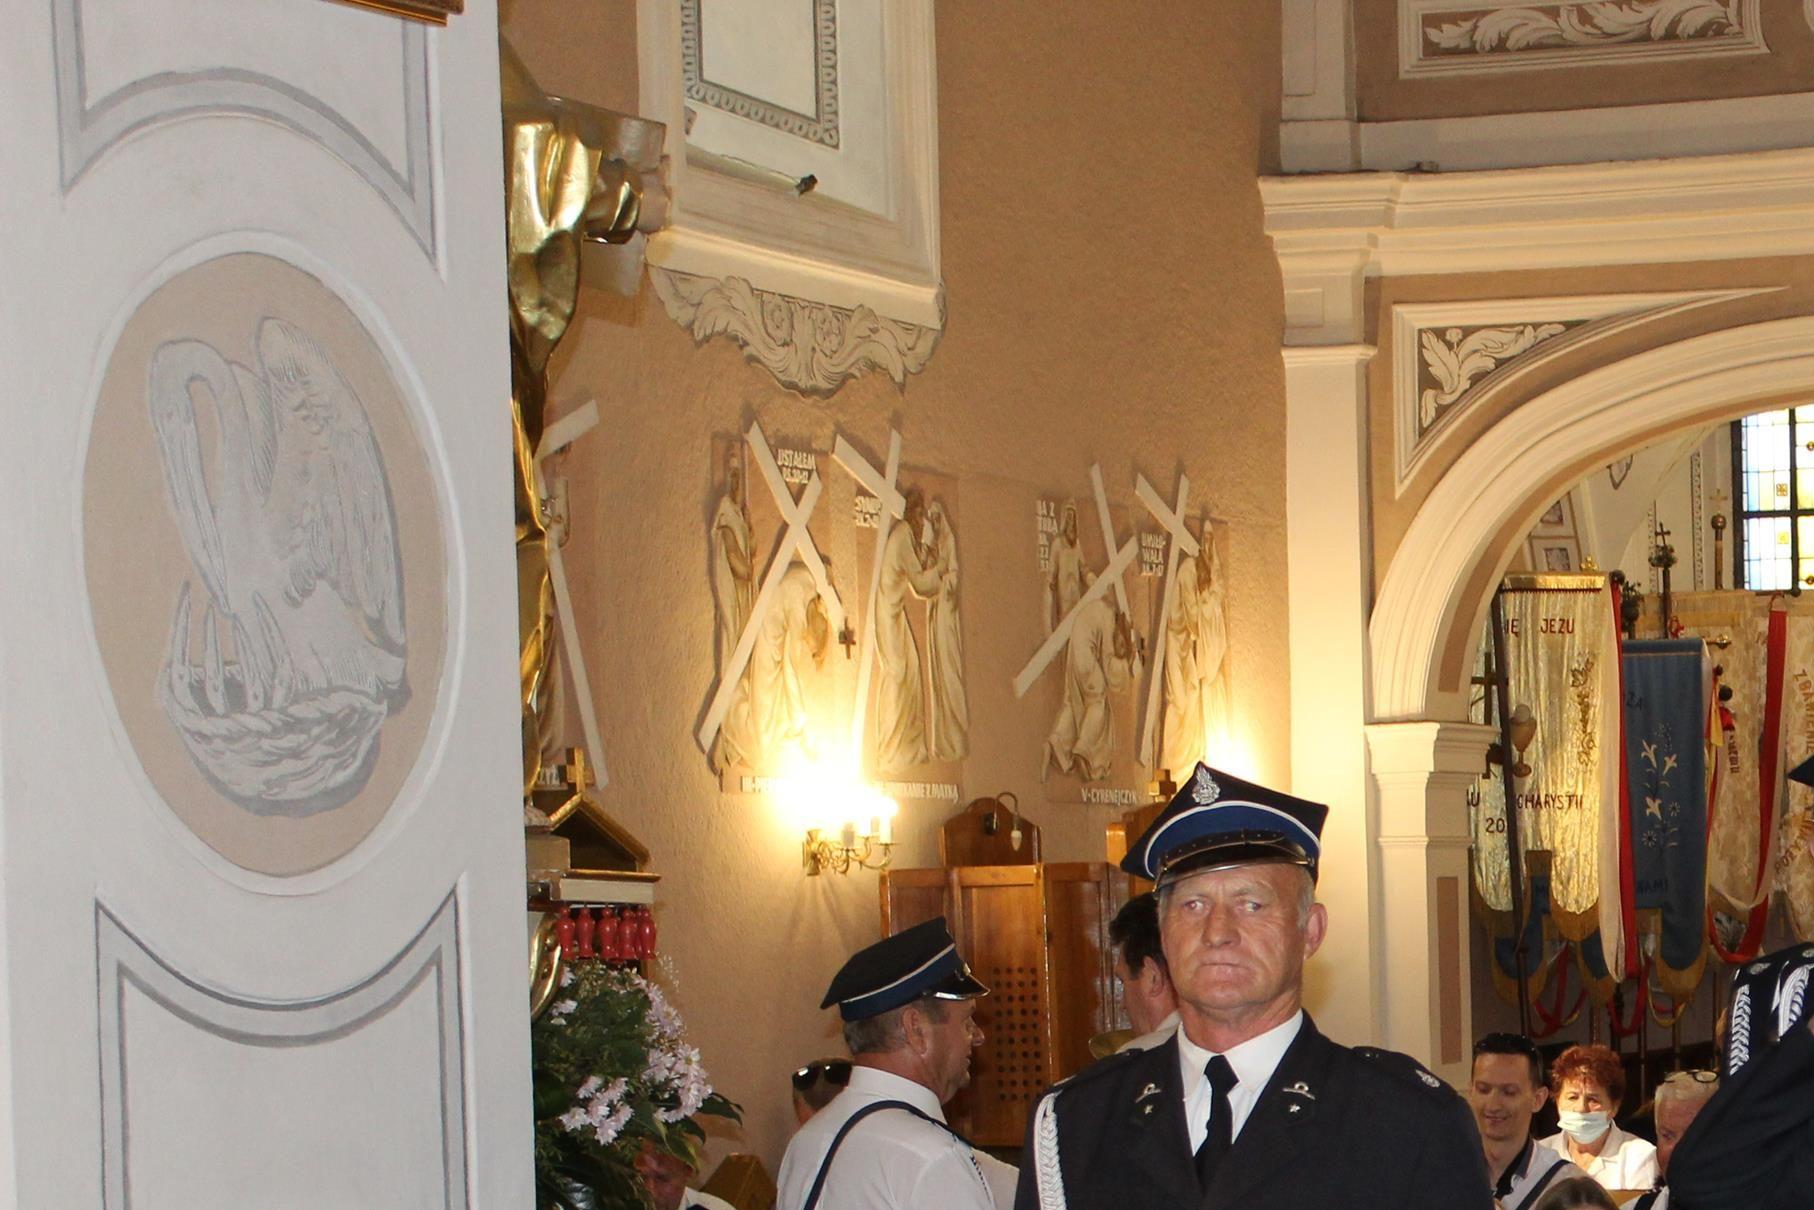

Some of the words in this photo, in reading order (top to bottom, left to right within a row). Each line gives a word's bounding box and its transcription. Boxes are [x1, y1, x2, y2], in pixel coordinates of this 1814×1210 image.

[1505, 618, 1519, 637] IĘ
[1540, 618, 1574, 634] JEZU
[1515, 793, 1582, 809] CHARYSTII
